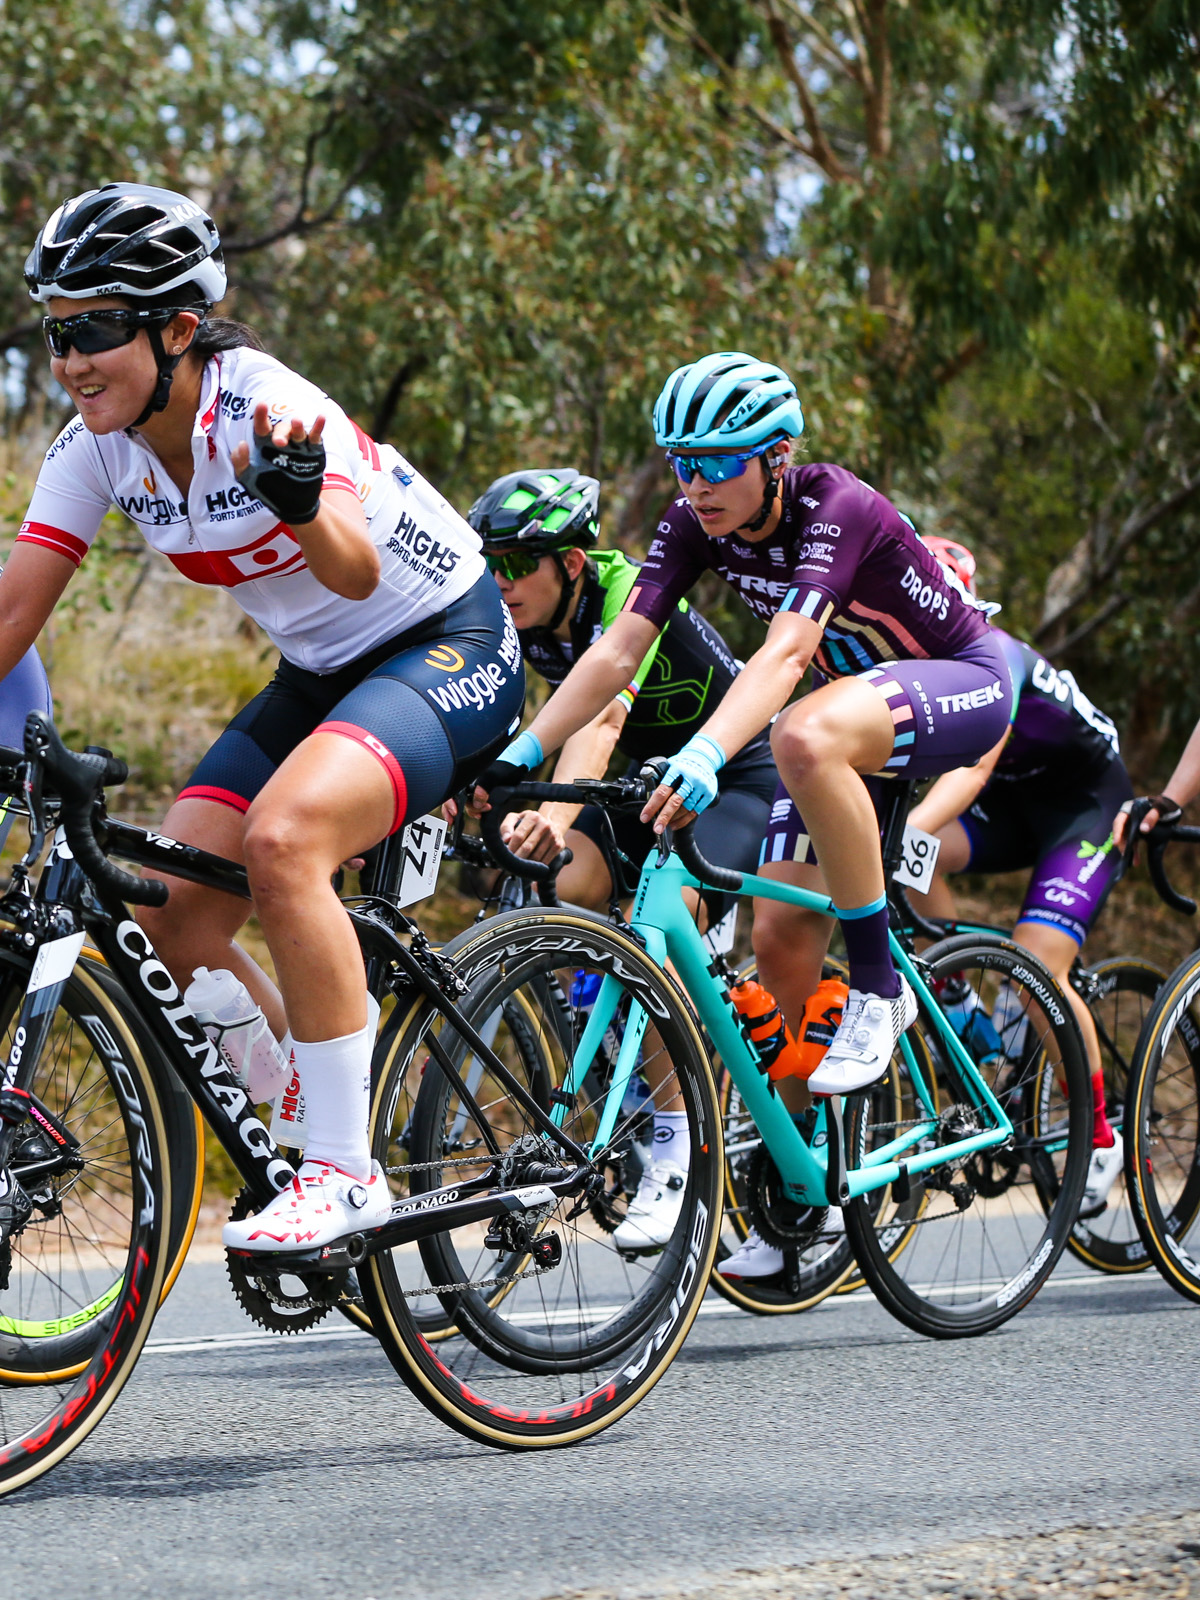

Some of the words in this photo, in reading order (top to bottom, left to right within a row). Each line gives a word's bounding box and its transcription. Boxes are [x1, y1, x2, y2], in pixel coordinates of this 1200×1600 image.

[96, 283, 123, 296] KASK
[210, 510, 235, 523] SPORTS
[386, 536, 411, 563] SPORTS
[394, 511, 461, 573] HIGH5
[900, 565, 951, 622] DROPS
[426, 661, 507, 713] wiggle
[912, 680, 935, 735] DROPS
[935, 680, 1005, 715] TREK
[906, 839, 929, 879] 66
[1011, 964, 1065, 1026] BONTRAGER
[28, 1106, 67, 1146] SPECIALIZED
[79, 1014, 154, 1232] BORA
[391, 1189, 460, 1216] COLNAGO
[517, 1188, 546, 1199] V2-R
[628, 1197, 709, 1385] BORA
[996, 1237, 1055, 1309] BONTRAGER
[25, 1247, 151, 1454] ULTRA
[458, 1378, 617, 1426] ULTRA
